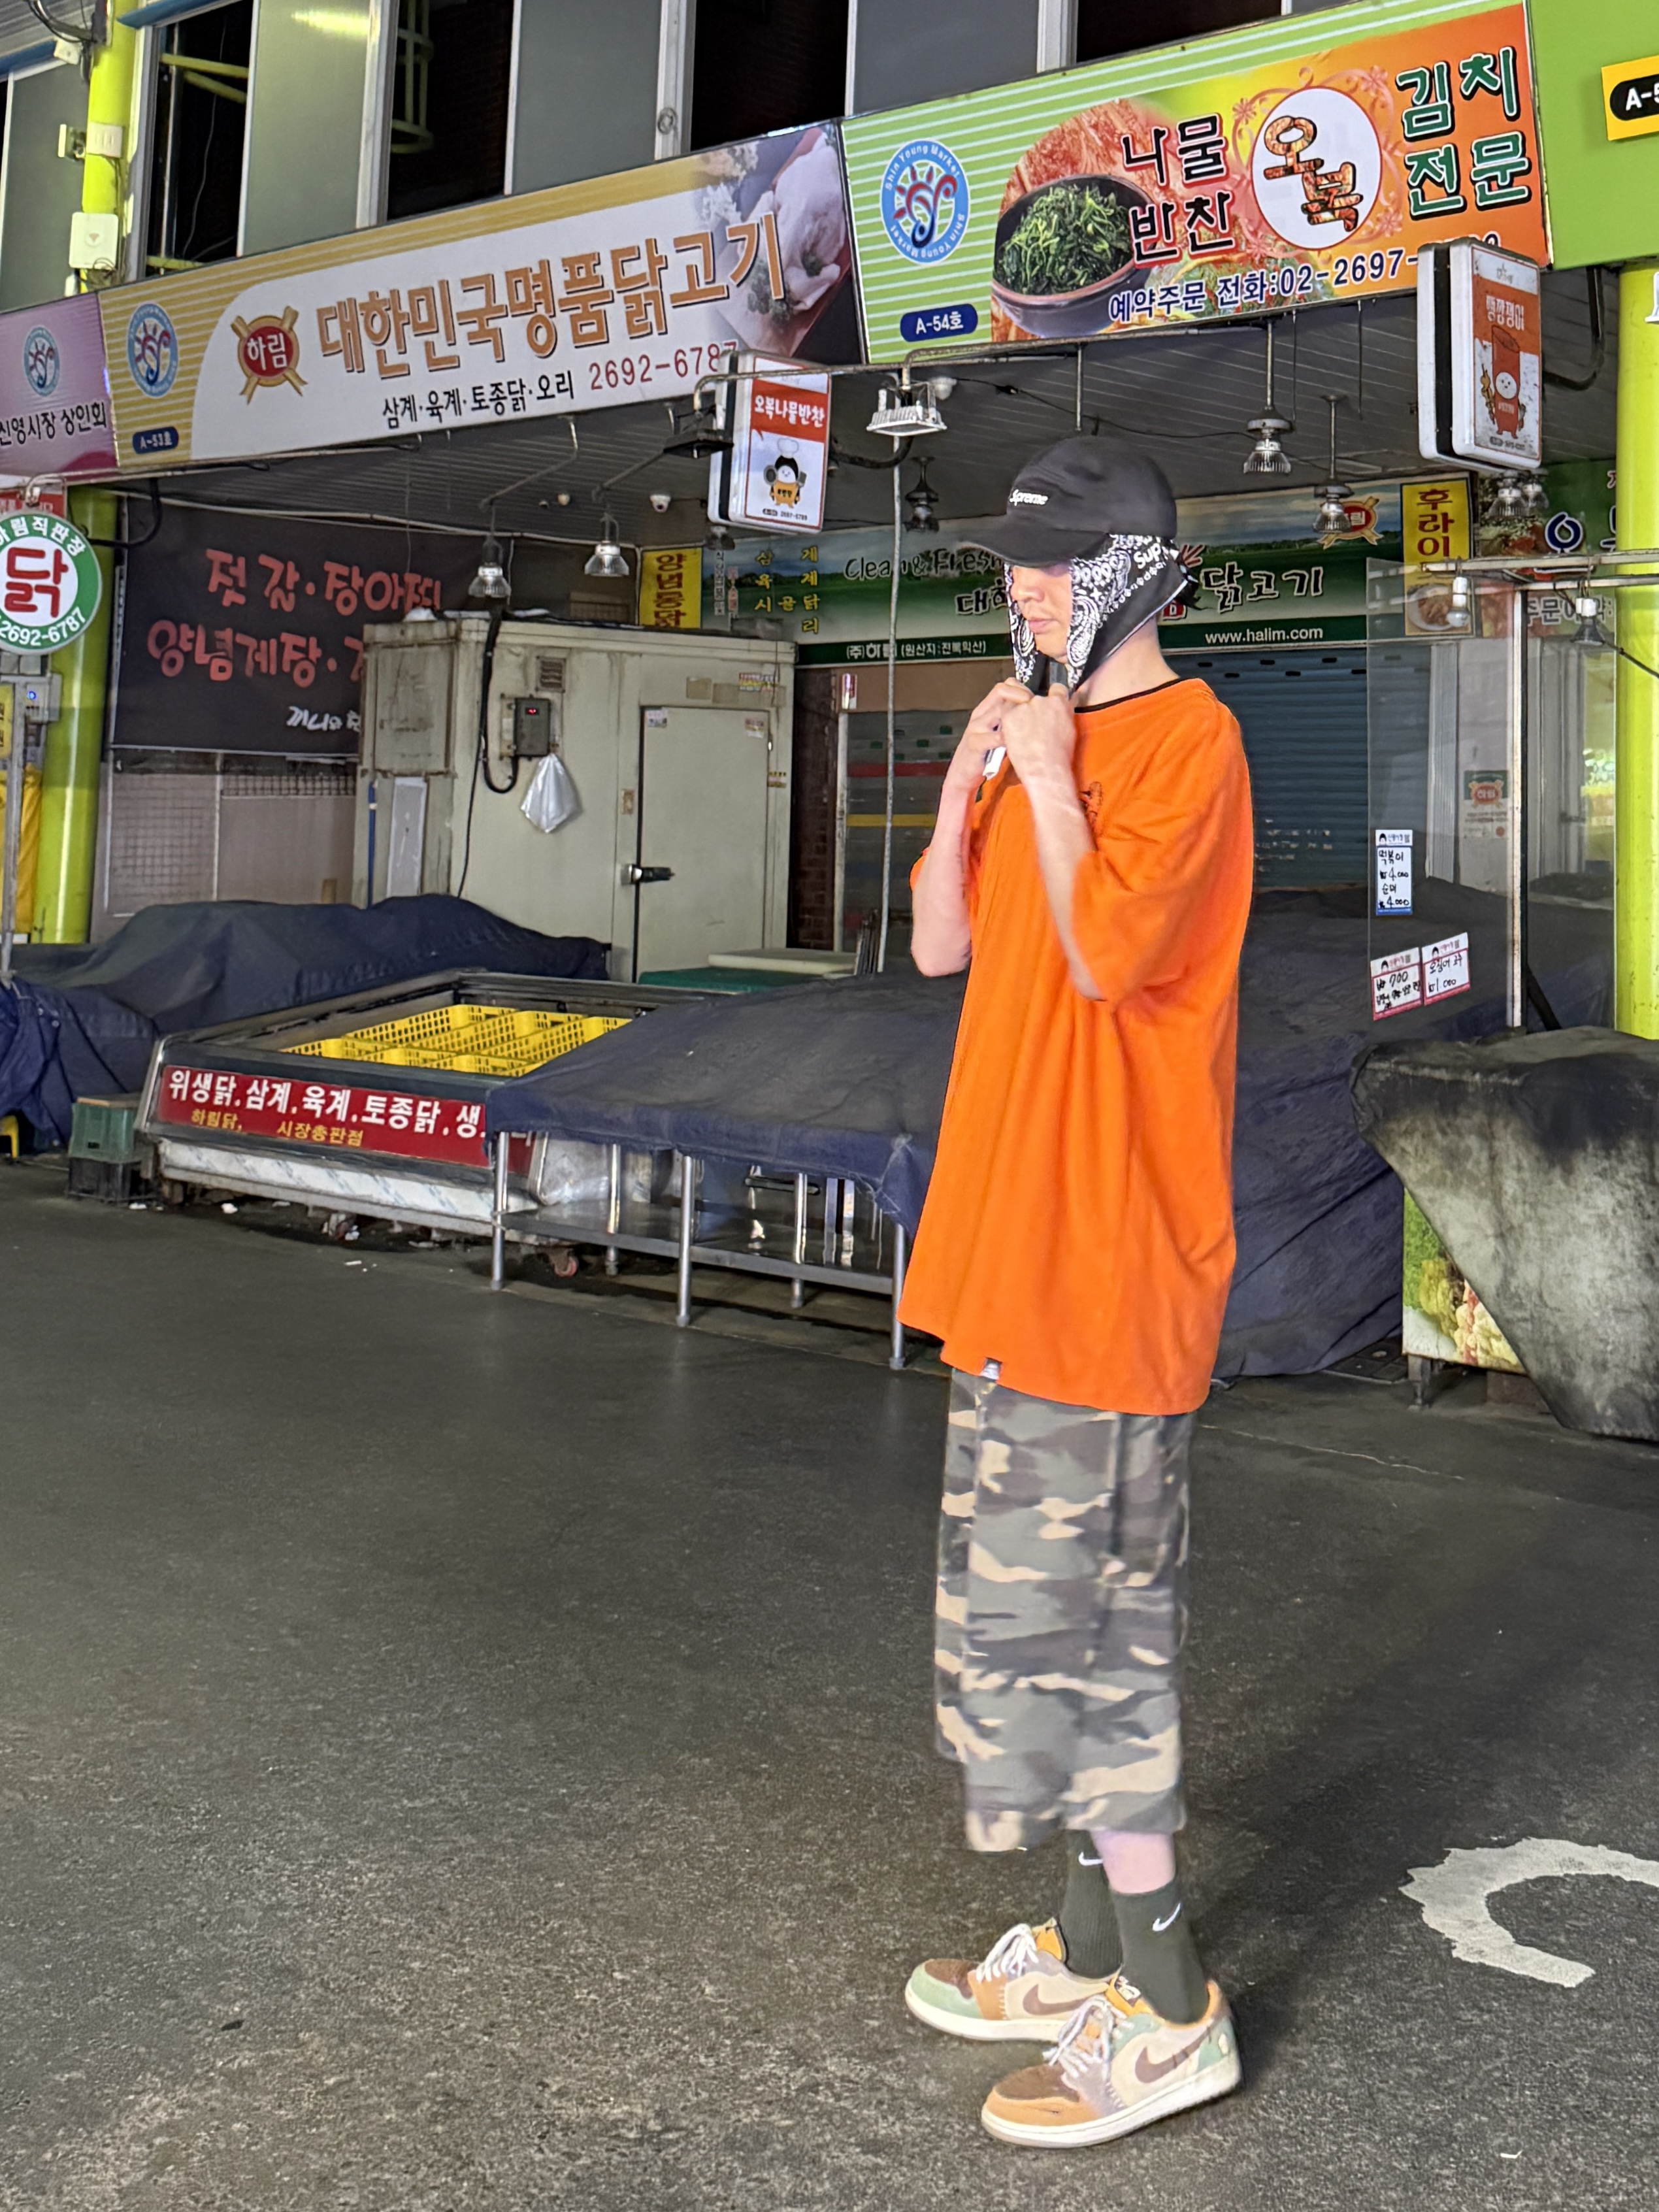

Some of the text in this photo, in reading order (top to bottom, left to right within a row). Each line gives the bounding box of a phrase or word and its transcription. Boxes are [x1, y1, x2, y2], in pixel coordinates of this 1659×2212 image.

[1396, 46, 1517, 142] 김치
[885, 144, 961, 191] Shin Young Market
[1122, 113, 1228, 187] 나물
[1262, 116, 1363, 231] 오복
[1405, 131, 1532, 220] 전문
[1130, 191, 1236, 265] 반찬
[317, 210, 785, 379] 대한민국명품닭고기
[1110, 280, 1206, 323] 예약주문
[916, 310, 964, 335] A-54호
[247, 332, 287, 371] 하림
[0, 402, 107, 446] 신영시장 상인회
[755, 395, 825, 428] 오복나물반찬
[1417, 489, 1456, 580] 후라이
[5, 547, 69, 618] 닭
[1201, 561, 1323, 614] 닭고기
[1205, 627, 1324, 644] www.halim.com
[276, 1120, 363, 1147] 시장총판점
